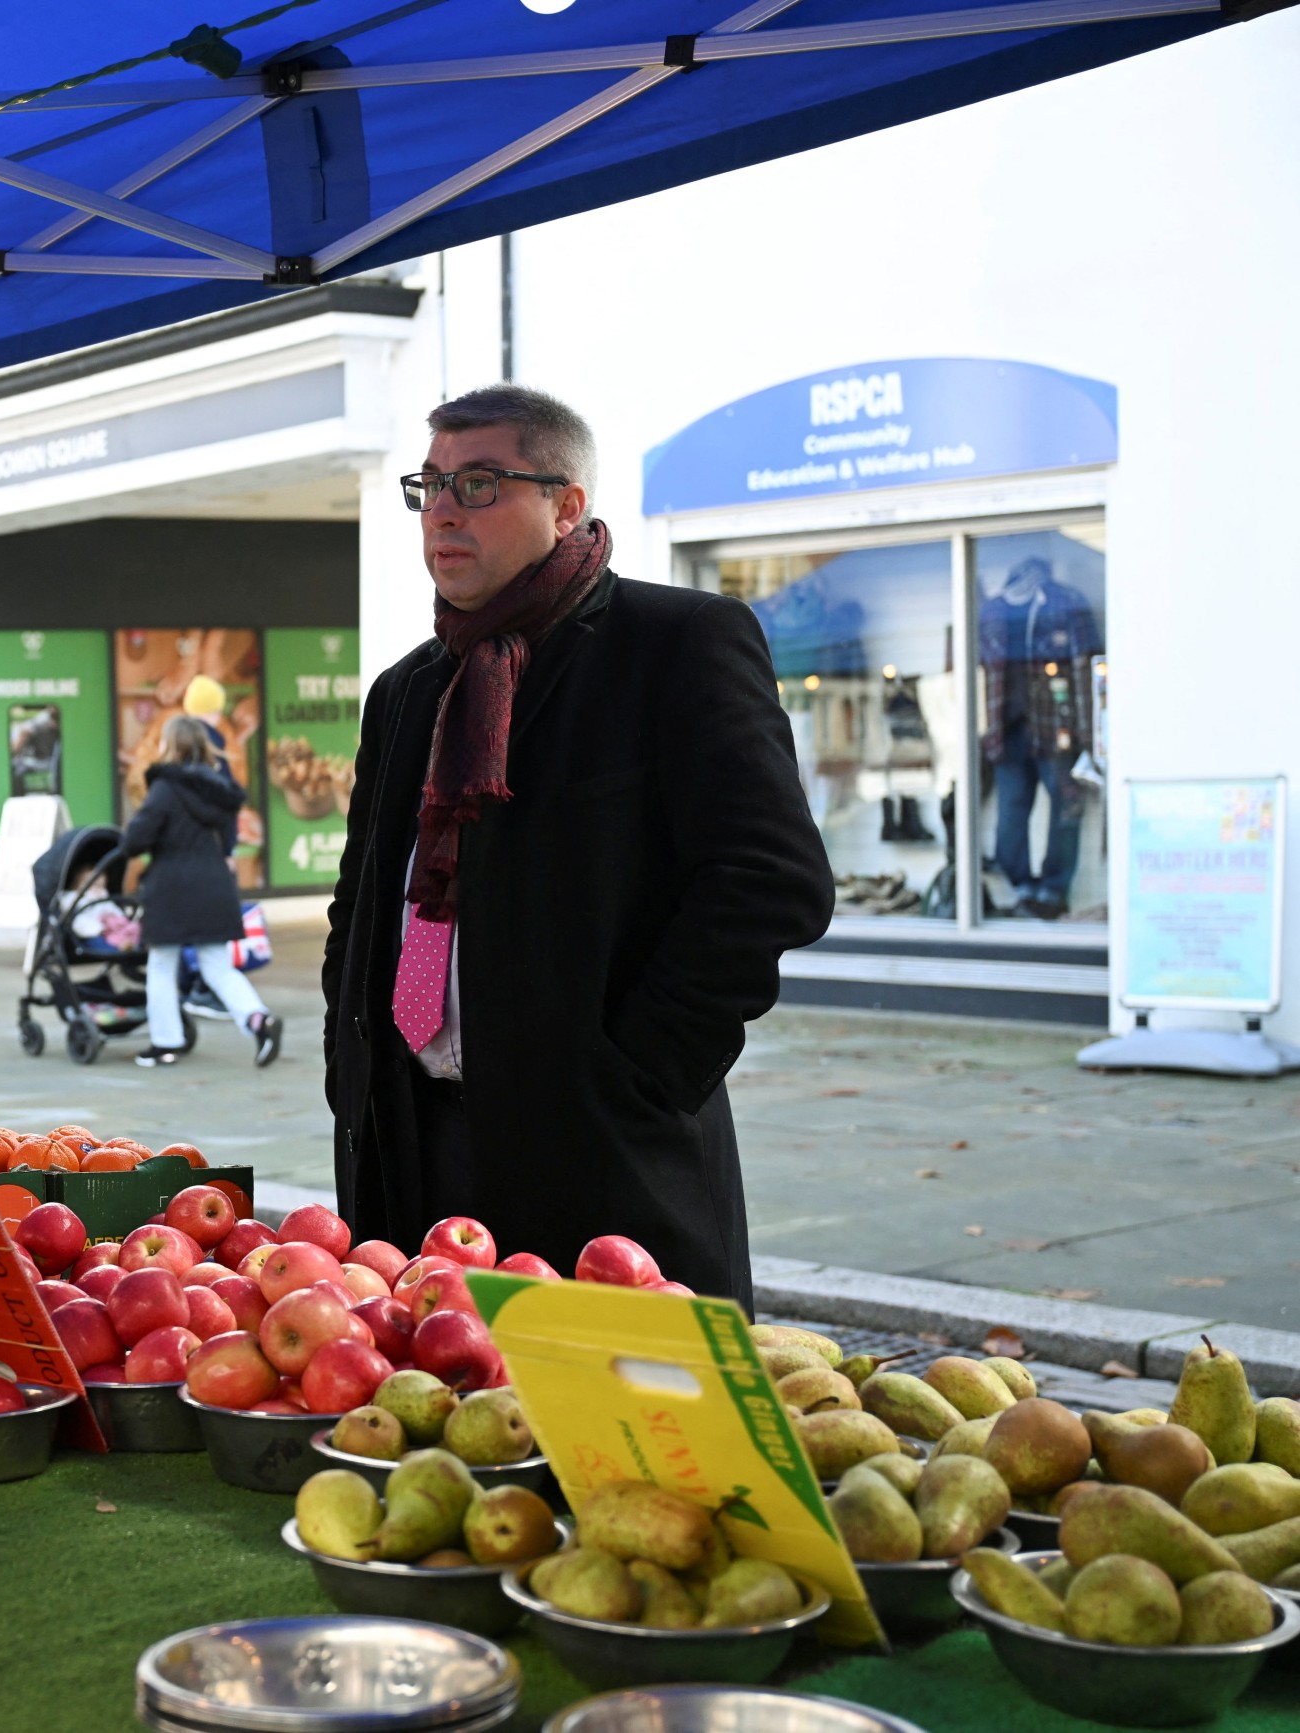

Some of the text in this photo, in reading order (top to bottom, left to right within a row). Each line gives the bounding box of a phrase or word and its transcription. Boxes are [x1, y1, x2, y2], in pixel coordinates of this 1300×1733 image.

[809, 372, 904, 427] RSPCA
[802, 422, 912, 456] Community
[746, 442, 977, 491] Education & Welfare Hub
[295, 674, 330, 700] TRY
[703, 1306, 797, 1472] Jumbo Ginger
